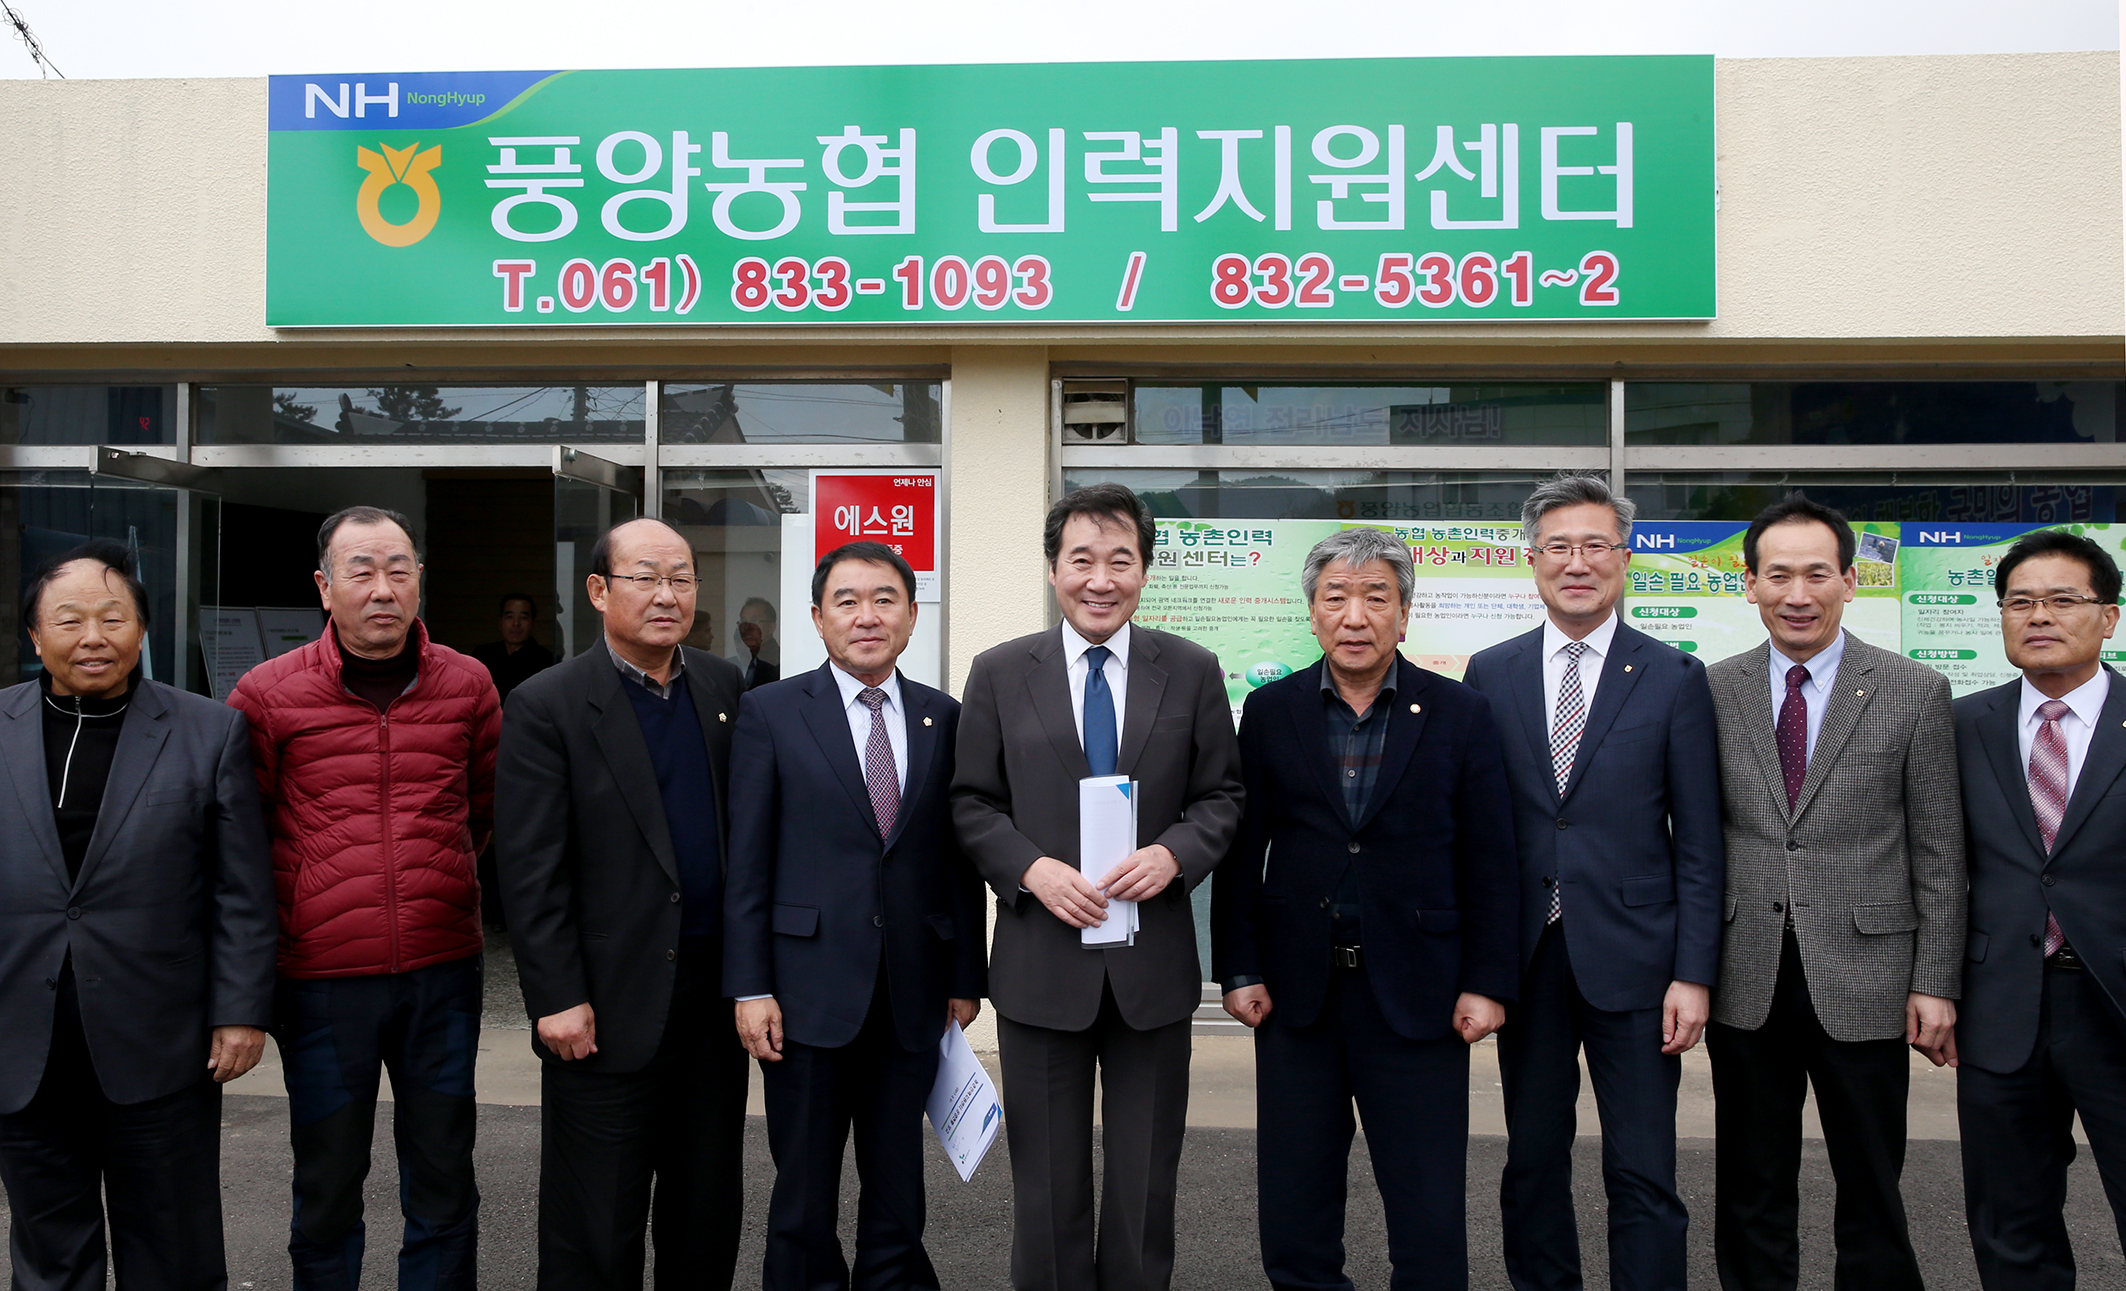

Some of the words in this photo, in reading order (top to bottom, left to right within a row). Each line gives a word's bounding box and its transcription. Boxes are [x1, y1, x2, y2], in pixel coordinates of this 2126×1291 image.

[305, 82, 399, 119] NH
[406, 91, 486, 107] NongHyup
[484, 125, 916, 242] 풍양농협
[970, 122, 1633, 233] 인력지원센터
[493, 254, 701, 314] T.061)
[731, 254, 1052, 312] 833-1093
[1116, 251, 1146, 311] /
[1210, 250, 1620, 309] 832-5361~2
[1163, 405, 1253, 439] 이낙연
[893, 478, 915, 487] 언제나
[917, 478, 932, 487] 안심
[834, 505, 914, 536] 에스원
[1155, 529, 1169, 545] 협
[1179, 529, 1273, 546] 농촌인력
[1395, 527, 1425, 541] 농협
[1636, 534, 1675, 548] NH
[1920, 531, 1961, 543] NH
[1183, 551, 1261, 567] 센터는?
[1470, 547, 1515, 566] 지원
[1688, 555, 1721, 568] 일손이
[1632, 572, 1665, 592] 일손
[1669, 572, 1701, 592] 필요
[1917, 595, 1959, 603] 신청대상
[1639, 608, 1680, 617] 신청대상
[1917, 650, 1958, 659] 신청방법
